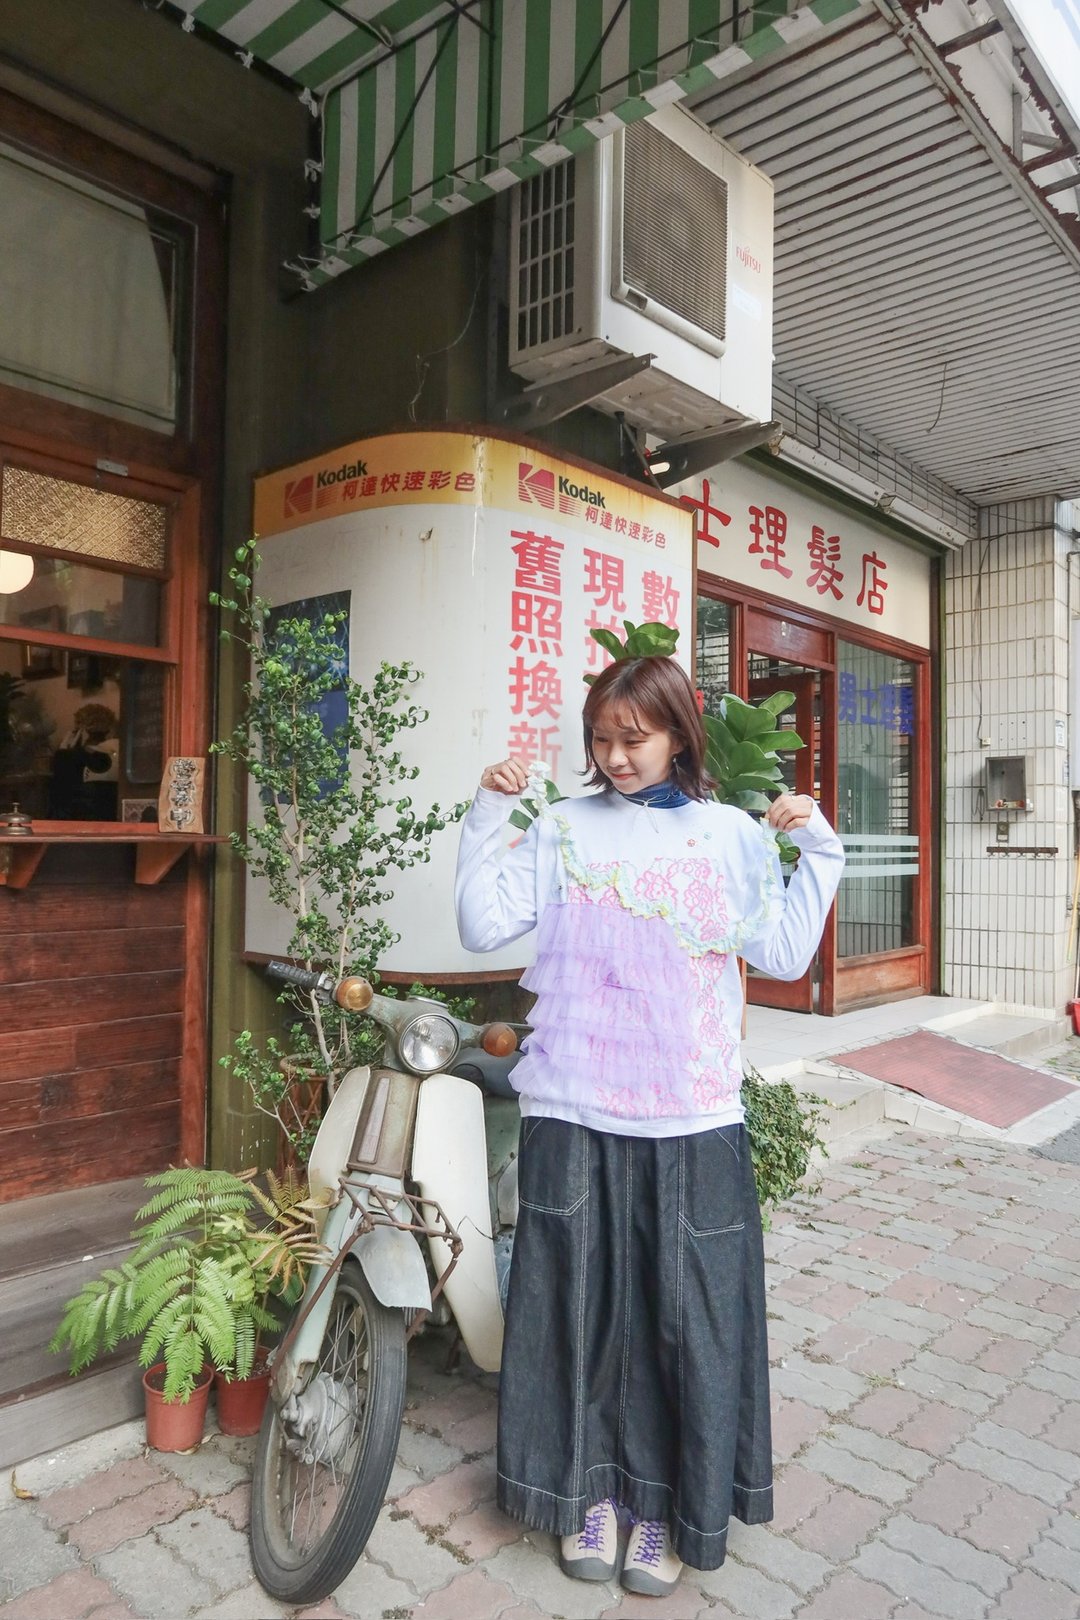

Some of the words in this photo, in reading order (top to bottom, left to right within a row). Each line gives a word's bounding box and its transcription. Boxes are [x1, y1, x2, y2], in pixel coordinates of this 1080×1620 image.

[736, 246, 761, 274] FUJITSU
[316, 459, 368, 488] Kodak
[342, 469, 476, 502] 柯達快速彩色
[558, 475, 606, 509] Kodak
[585, 505, 667, 550] 柯達快速彩色
[583, 547, 628, 696] 現拍
[508, 530, 565, 784] 舊照換新
